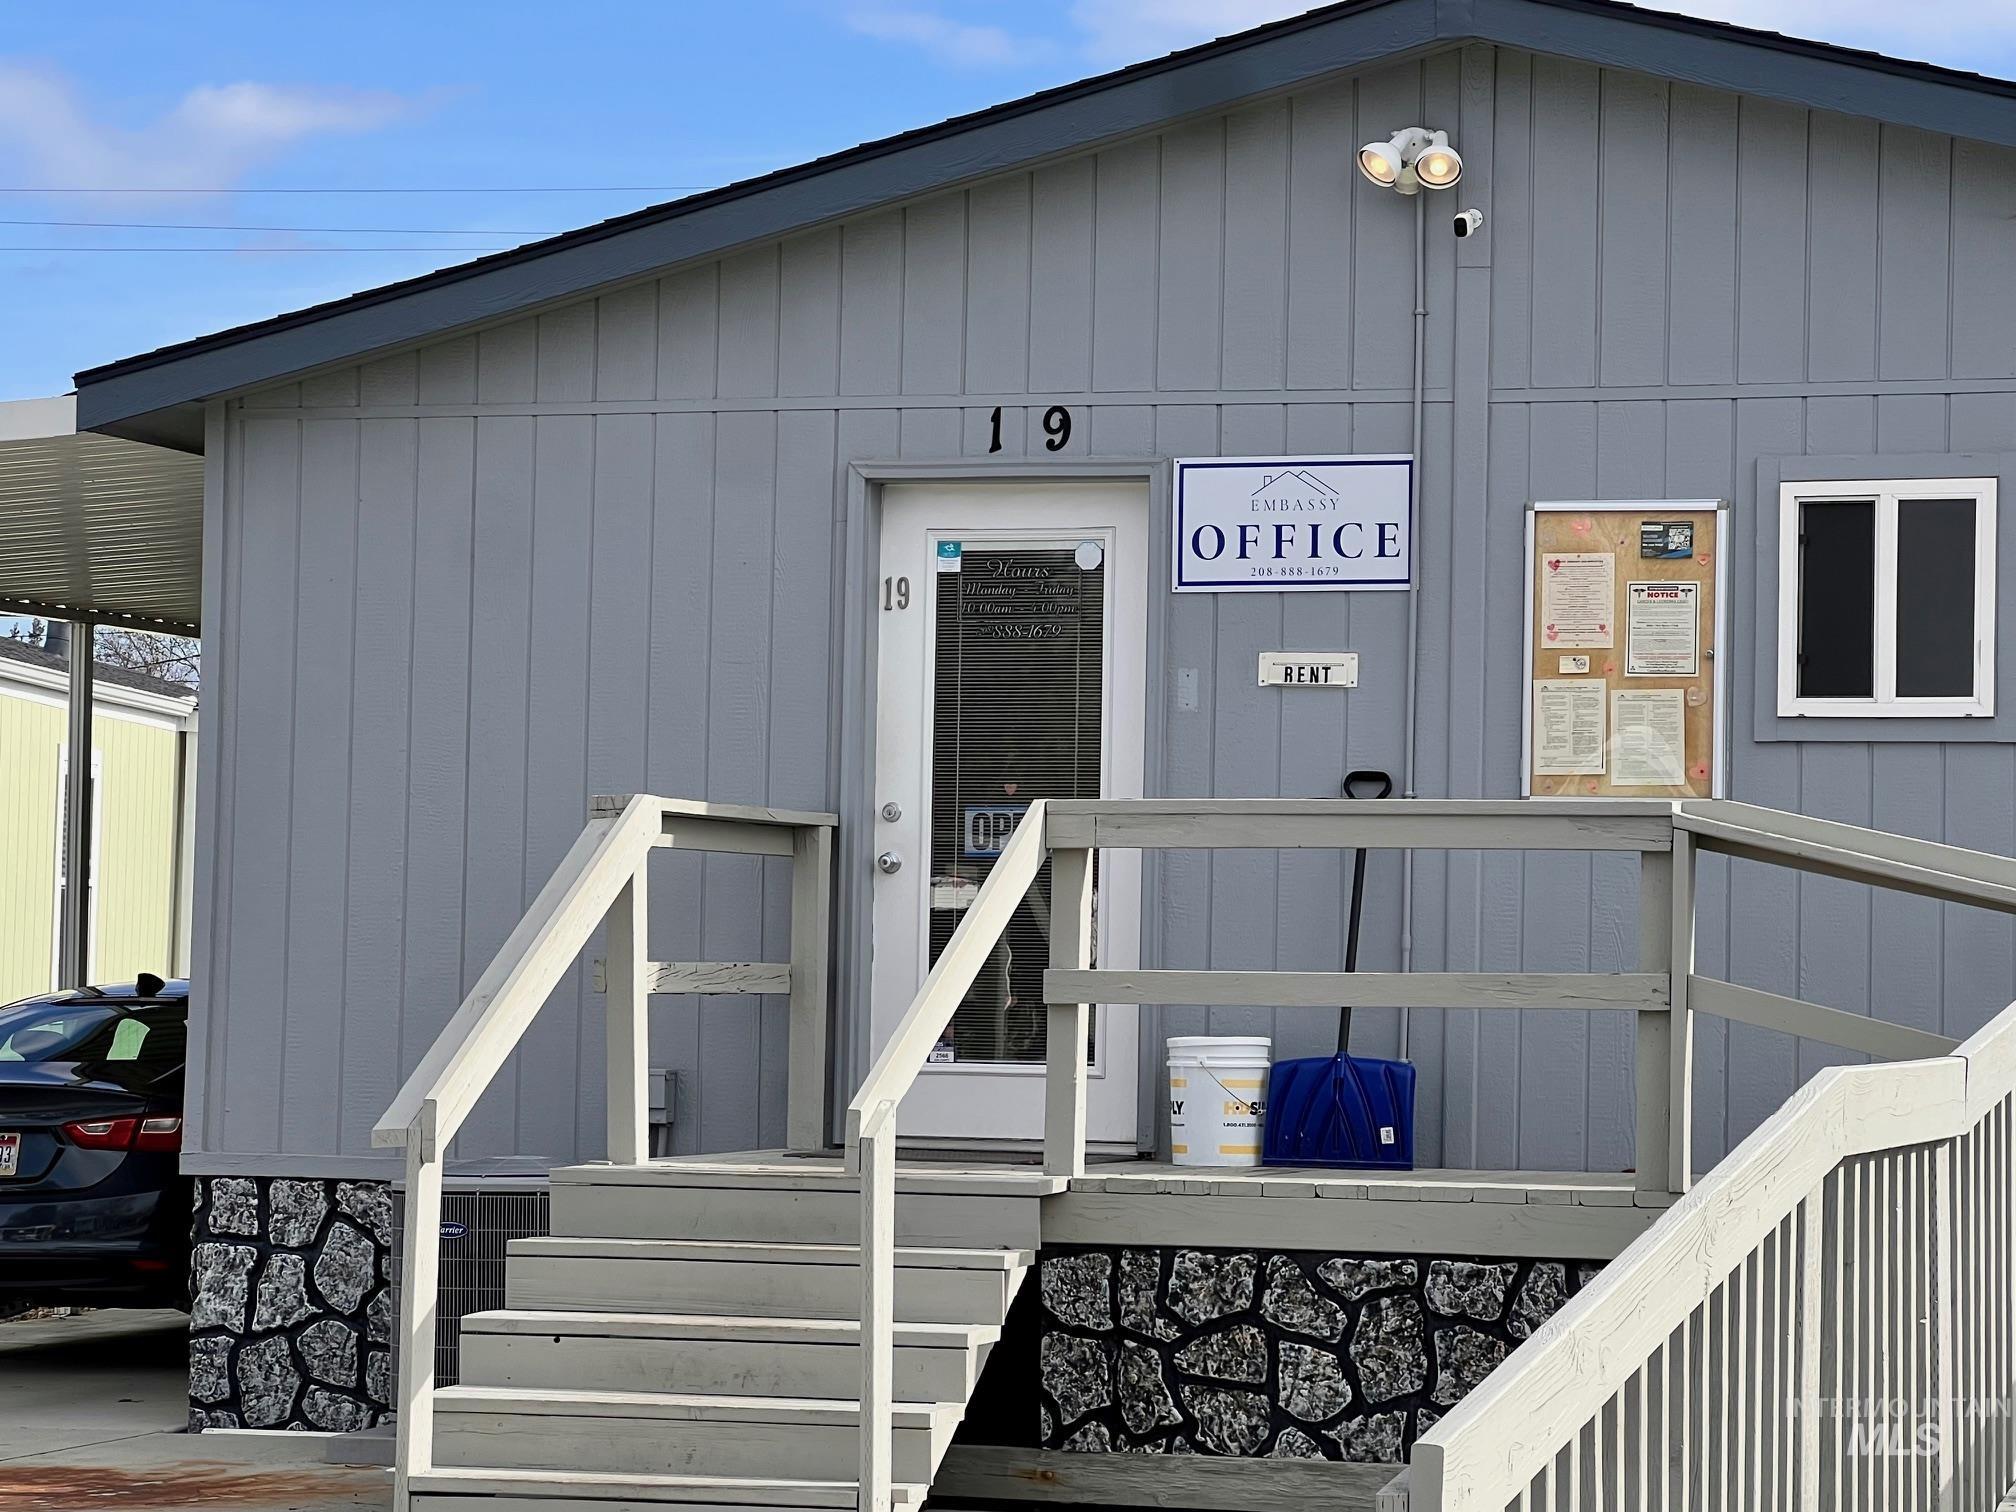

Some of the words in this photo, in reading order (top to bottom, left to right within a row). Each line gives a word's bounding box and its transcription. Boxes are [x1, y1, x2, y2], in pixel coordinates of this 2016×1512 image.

[1251, 498, 1339, 511] EMBASSY
[1191, 522, 1401, 560] OFFICE
[986, 558, 1050, 578] Hours
[1250, 566, 1339, 577] 208-888-1679
[884, 576, 910, 611] 19
[964, 582, 1016, 599] Monday
[1284, 666, 1332, 683] RENT
